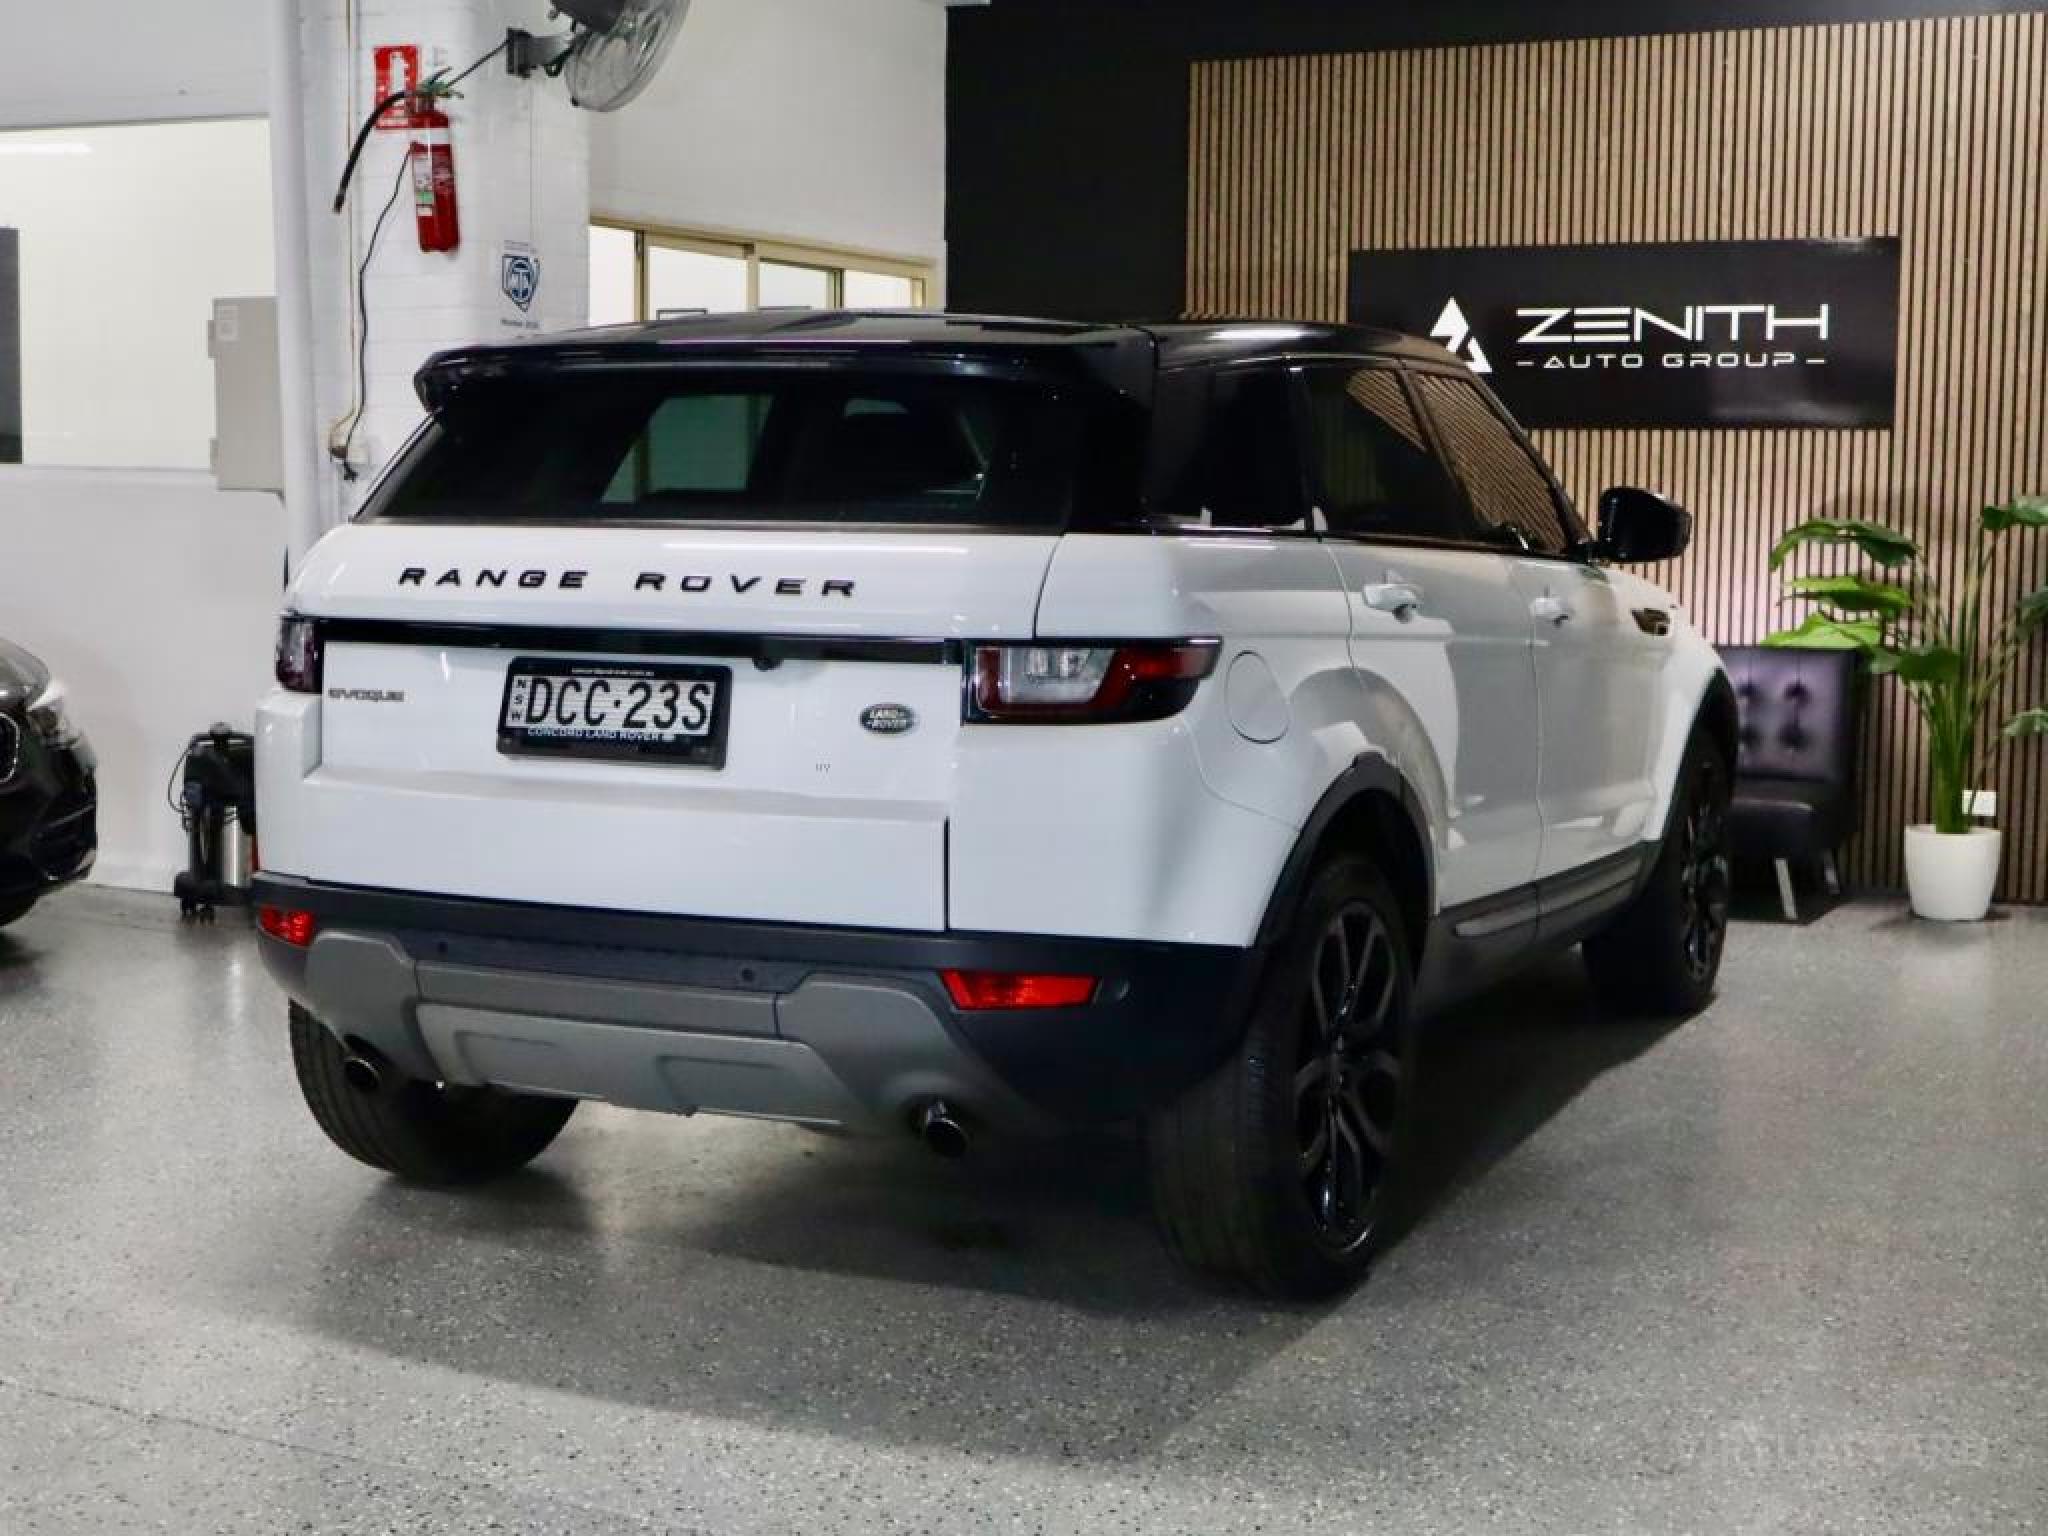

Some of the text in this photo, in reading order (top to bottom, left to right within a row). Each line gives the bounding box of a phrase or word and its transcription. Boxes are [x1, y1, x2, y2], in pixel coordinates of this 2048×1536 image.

[1516, 303, 1829, 344] ZENITH
[1542, 351, 1796, 370] AUTO GROUP
[398, 566, 858, 598] RANGE ROVER
[587, 730, 617, 740] LAND
[619, 731, 661, 742] ROVER
